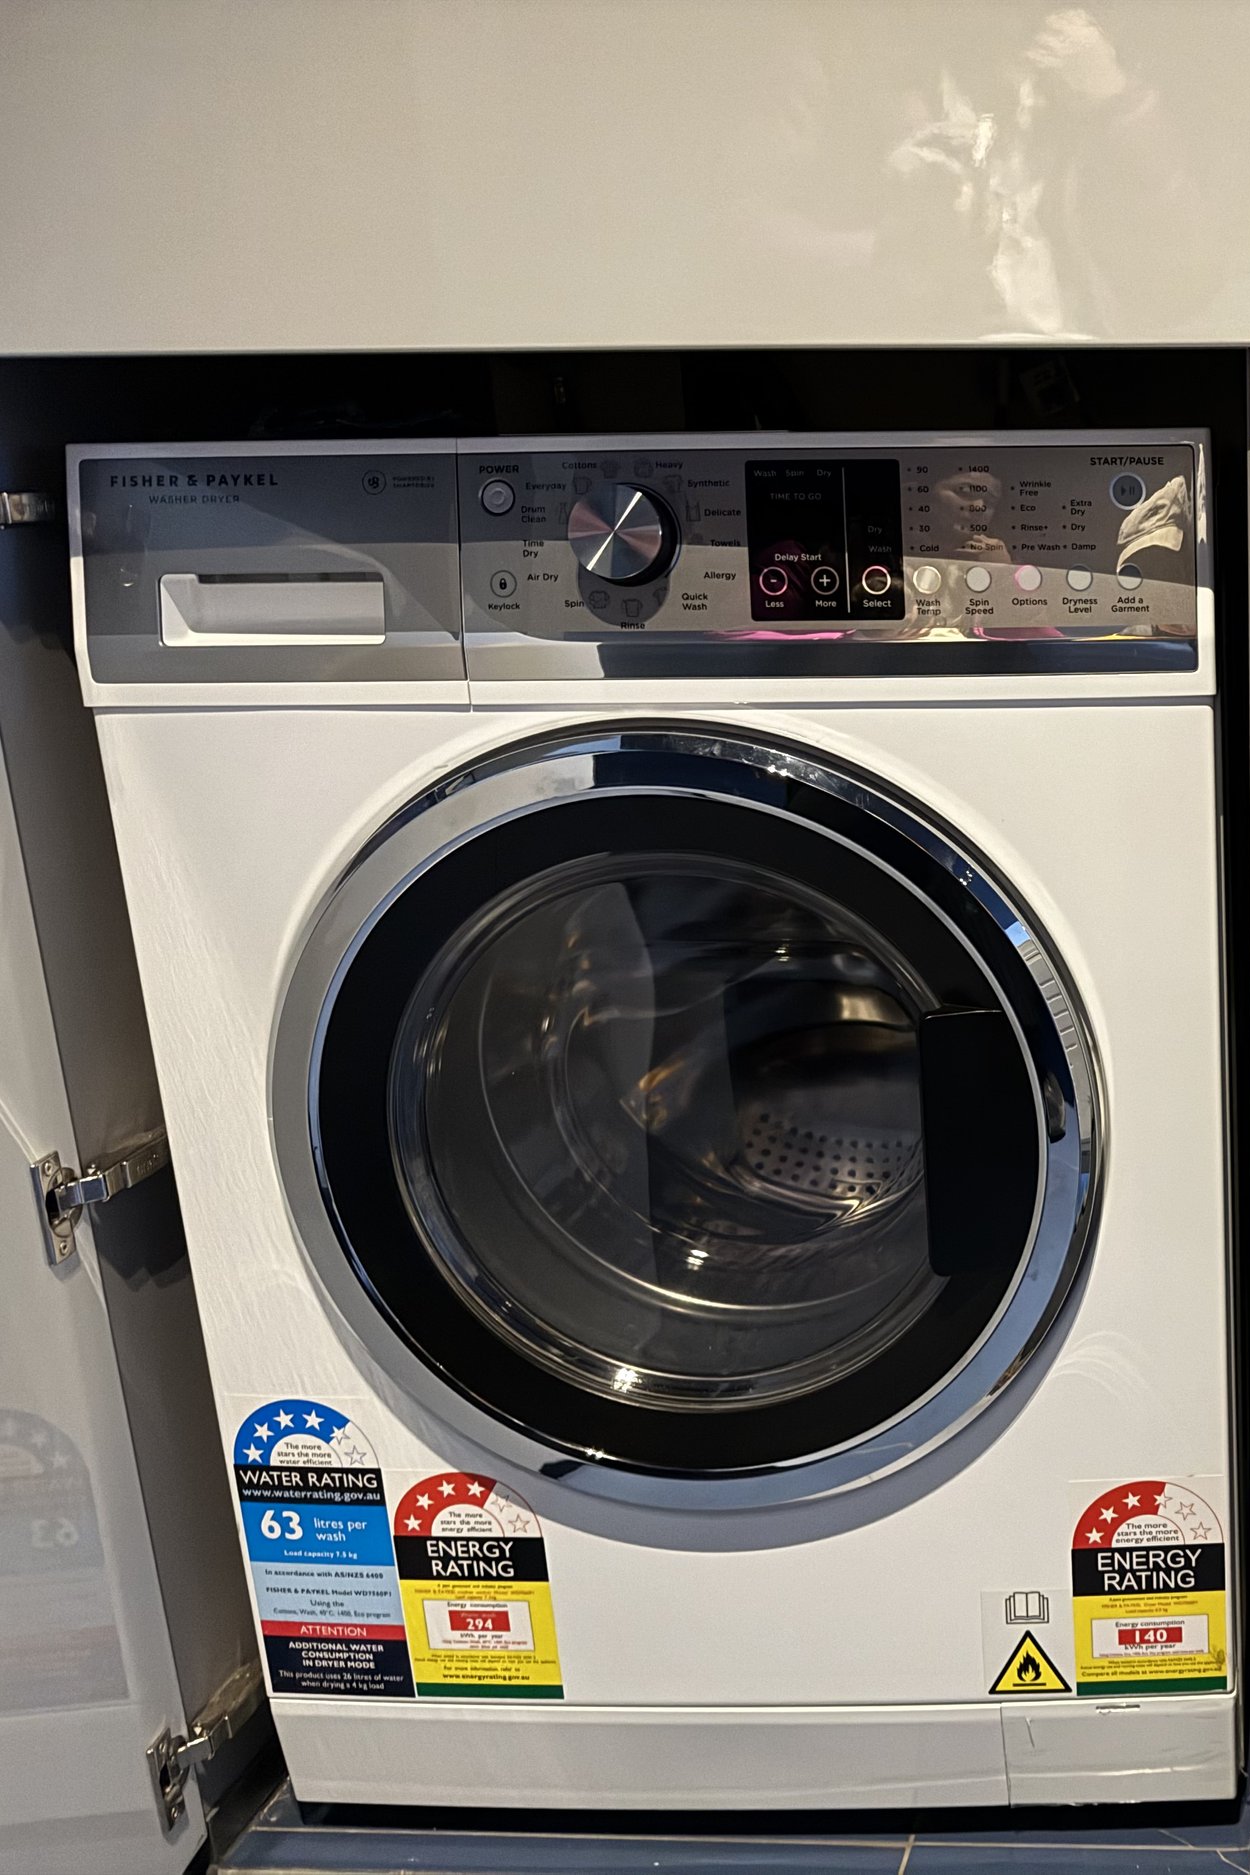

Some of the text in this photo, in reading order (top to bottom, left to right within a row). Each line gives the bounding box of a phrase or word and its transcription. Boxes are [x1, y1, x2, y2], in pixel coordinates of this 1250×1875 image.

[562, 461, 597, 469] Cottons
[655, 461, 683, 470] Heavy
[1090, 457, 1164, 465] START/PAUSE
[479, 465, 519, 474] POWER
[110, 473, 278, 487] FISHER & PAYKEL
[688, 479, 730, 489] Synthetic
[526, 482, 567, 491] Everyday
[149, 495, 240, 504] WASHER DRYER
[1071, 508, 1085, 516] Dry
[868, 526, 882, 534] Dry
[1072, 544, 1096, 552] Damp
[523, 550, 538, 558] Dry
[775, 554, 799, 562] Delay
[527, 573, 558, 582] Air Dry
[704, 572, 736, 580] Allergy
[682, 593, 708, 601] Quick
[565, 600, 584, 608] Spin
[970, 599, 989, 607] Spin
[1012, 598, 1047, 606] Options
[1063, 598, 1097, 606] Dryness
[917, 608, 941, 616] Temp
[965, 607, 994, 615] Speed
[240, 1470, 377, 1488] WATER RATING
[243, 1488, 380, 1502] www.waterrating.gov.au
[261, 1510, 367, 1539] 63 litres per
[316, 1531, 345, 1541] wash
[426, 1541, 513, 1557] ENERGY
[1098, 1549, 1202, 1571] ENERGY
[431, 1560, 514, 1577] RATING
[1104, 1570, 1195, 1591] RATING
[466, 1619, 492, 1630] 294
[300, 1625, 366, 1636] ATTENTION
[1135, 1630, 1167, 1643] 140
[289, 1642, 384, 1652] ADDITIONAL WATER
[302, 1651, 373, 1660] CONSUMPTION
[316, 1660, 345, 1668] DRYER
[347, 1661, 375, 1669] MODE
[322, 1681, 344, 1689] drying
